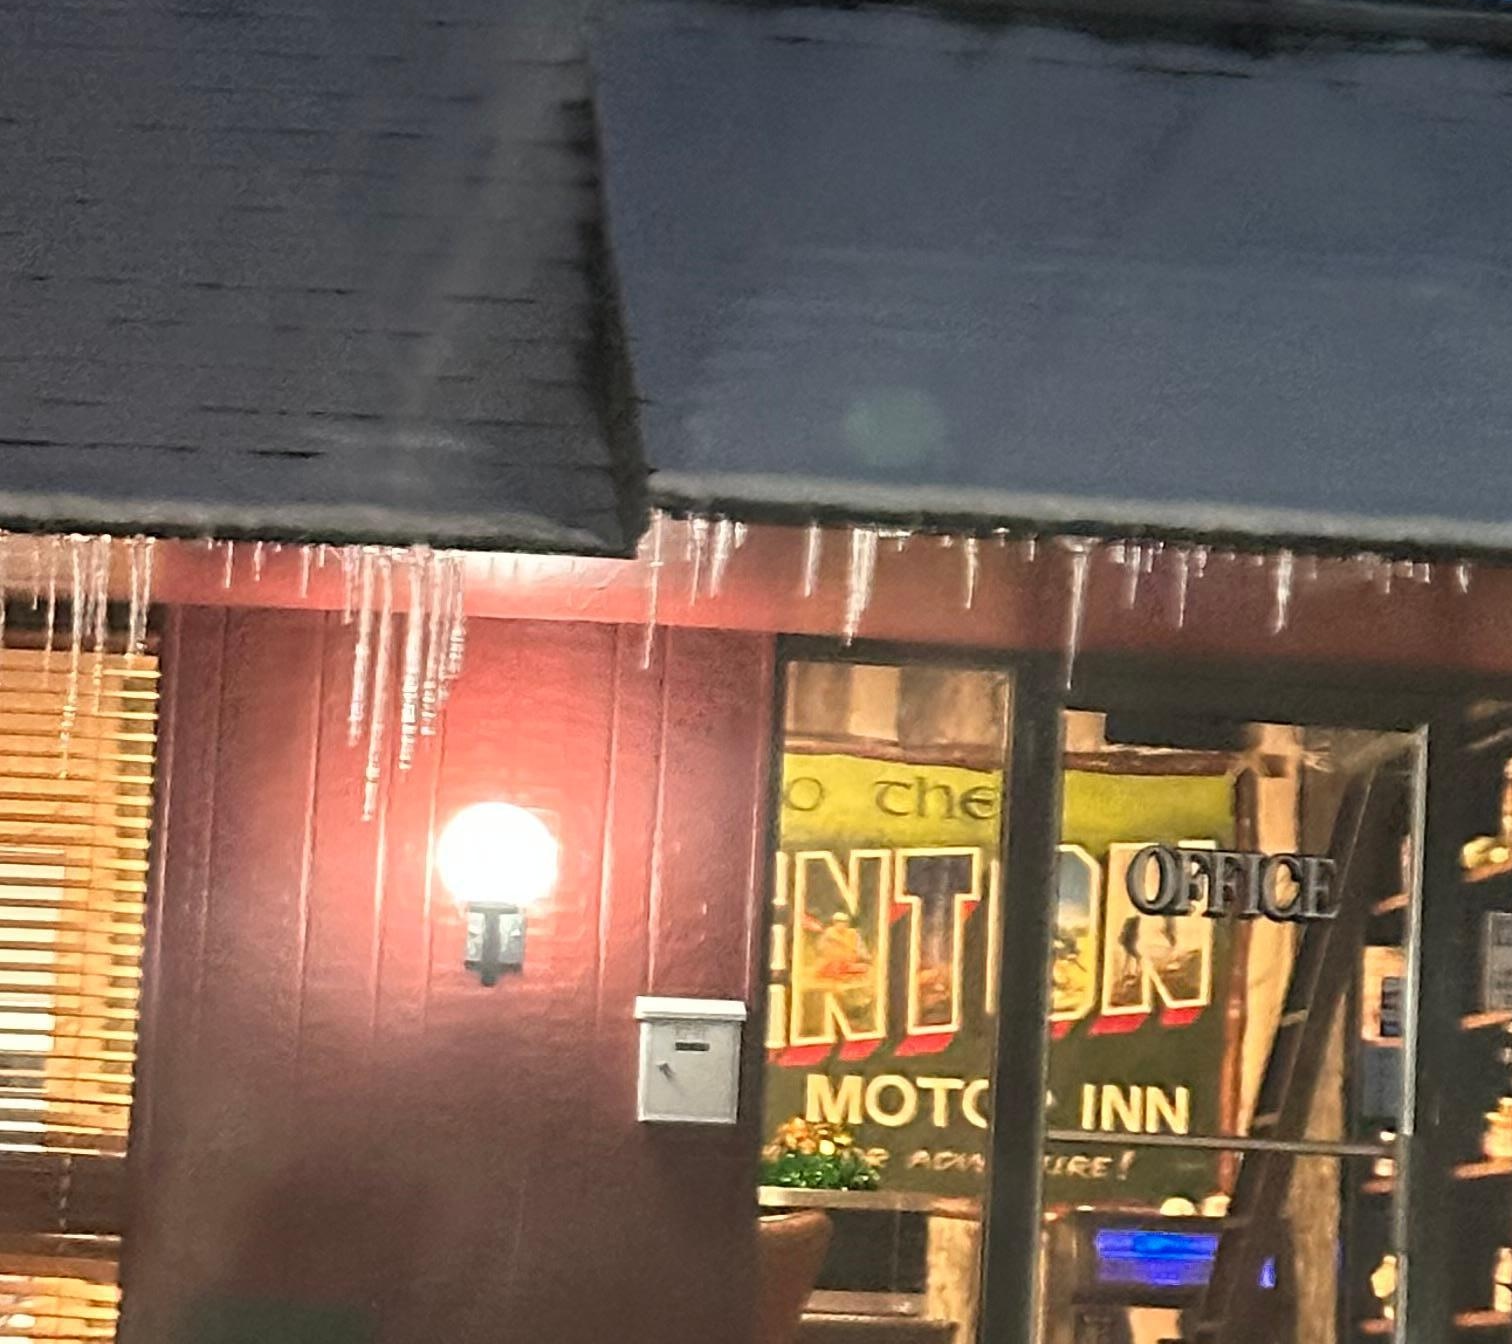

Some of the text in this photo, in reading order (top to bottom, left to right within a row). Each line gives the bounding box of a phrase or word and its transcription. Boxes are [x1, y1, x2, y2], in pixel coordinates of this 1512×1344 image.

[1126, 843, 1341, 922] OFFICE
[805, 1074, 1190, 1134] MOTO INN
